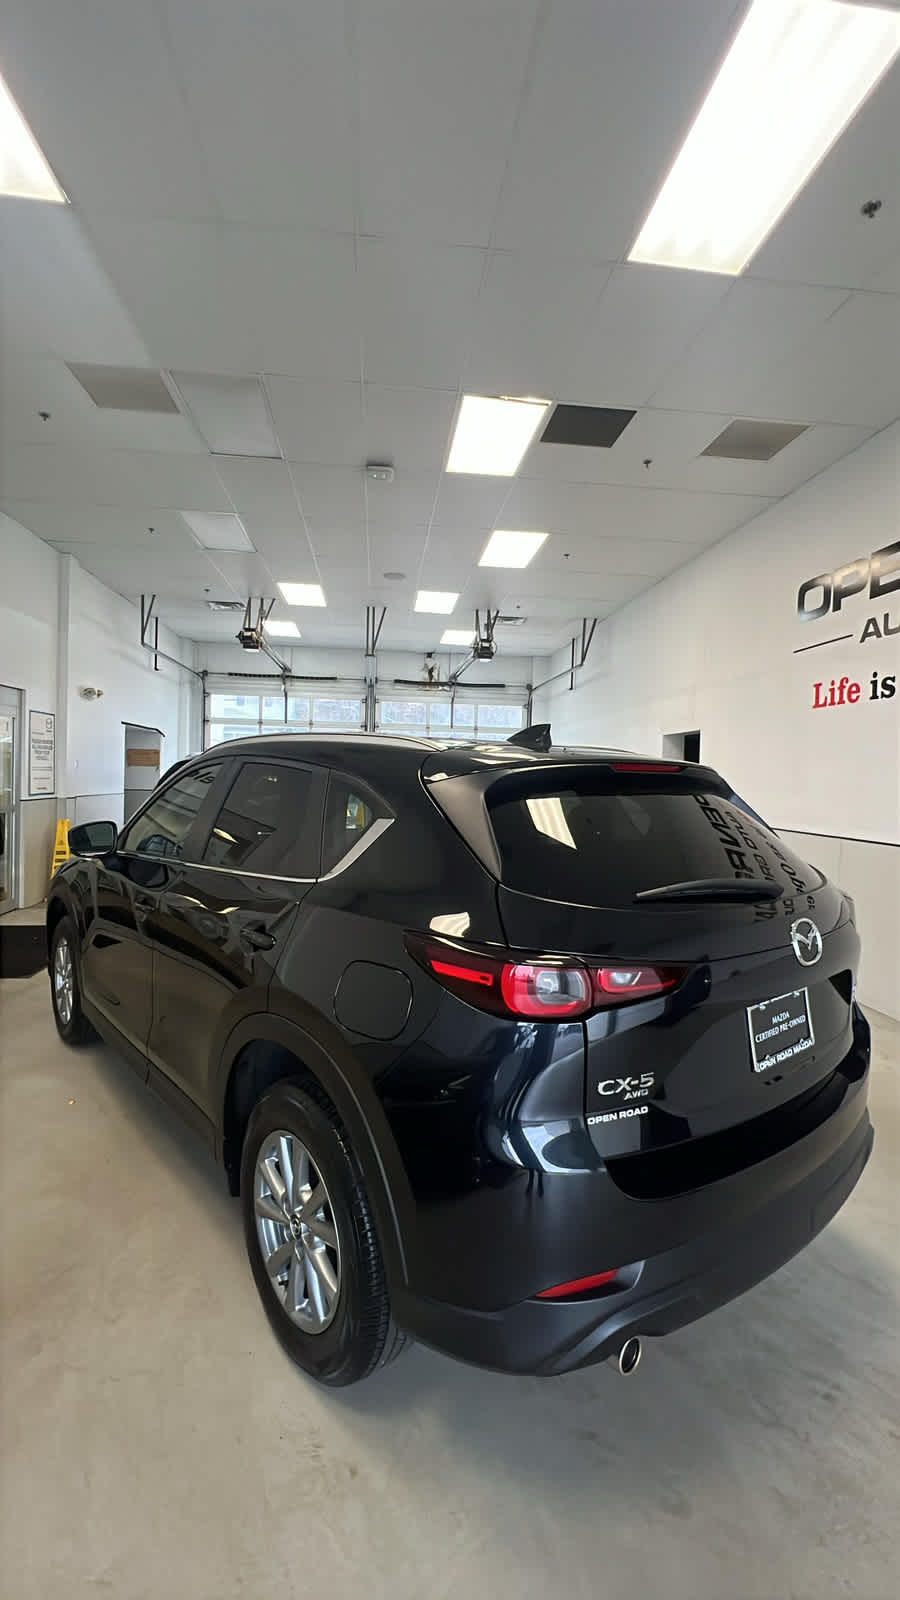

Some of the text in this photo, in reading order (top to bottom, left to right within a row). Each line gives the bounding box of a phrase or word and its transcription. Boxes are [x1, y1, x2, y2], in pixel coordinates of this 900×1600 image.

[812, 671, 896, 709] Life is
[755, 1015, 806, 1042] CERTIFIED PRE-OWNED
[771, 1011, 790, 1024] MAZDA
[760, 1039, 813, 1070] OPEN ROAD MAZDA
[598, 1072, 654, 1095] CX-5
[624, 1088, 649, 1100] AWD
[587, 1106, 649, 1125] OPEN ROAD
